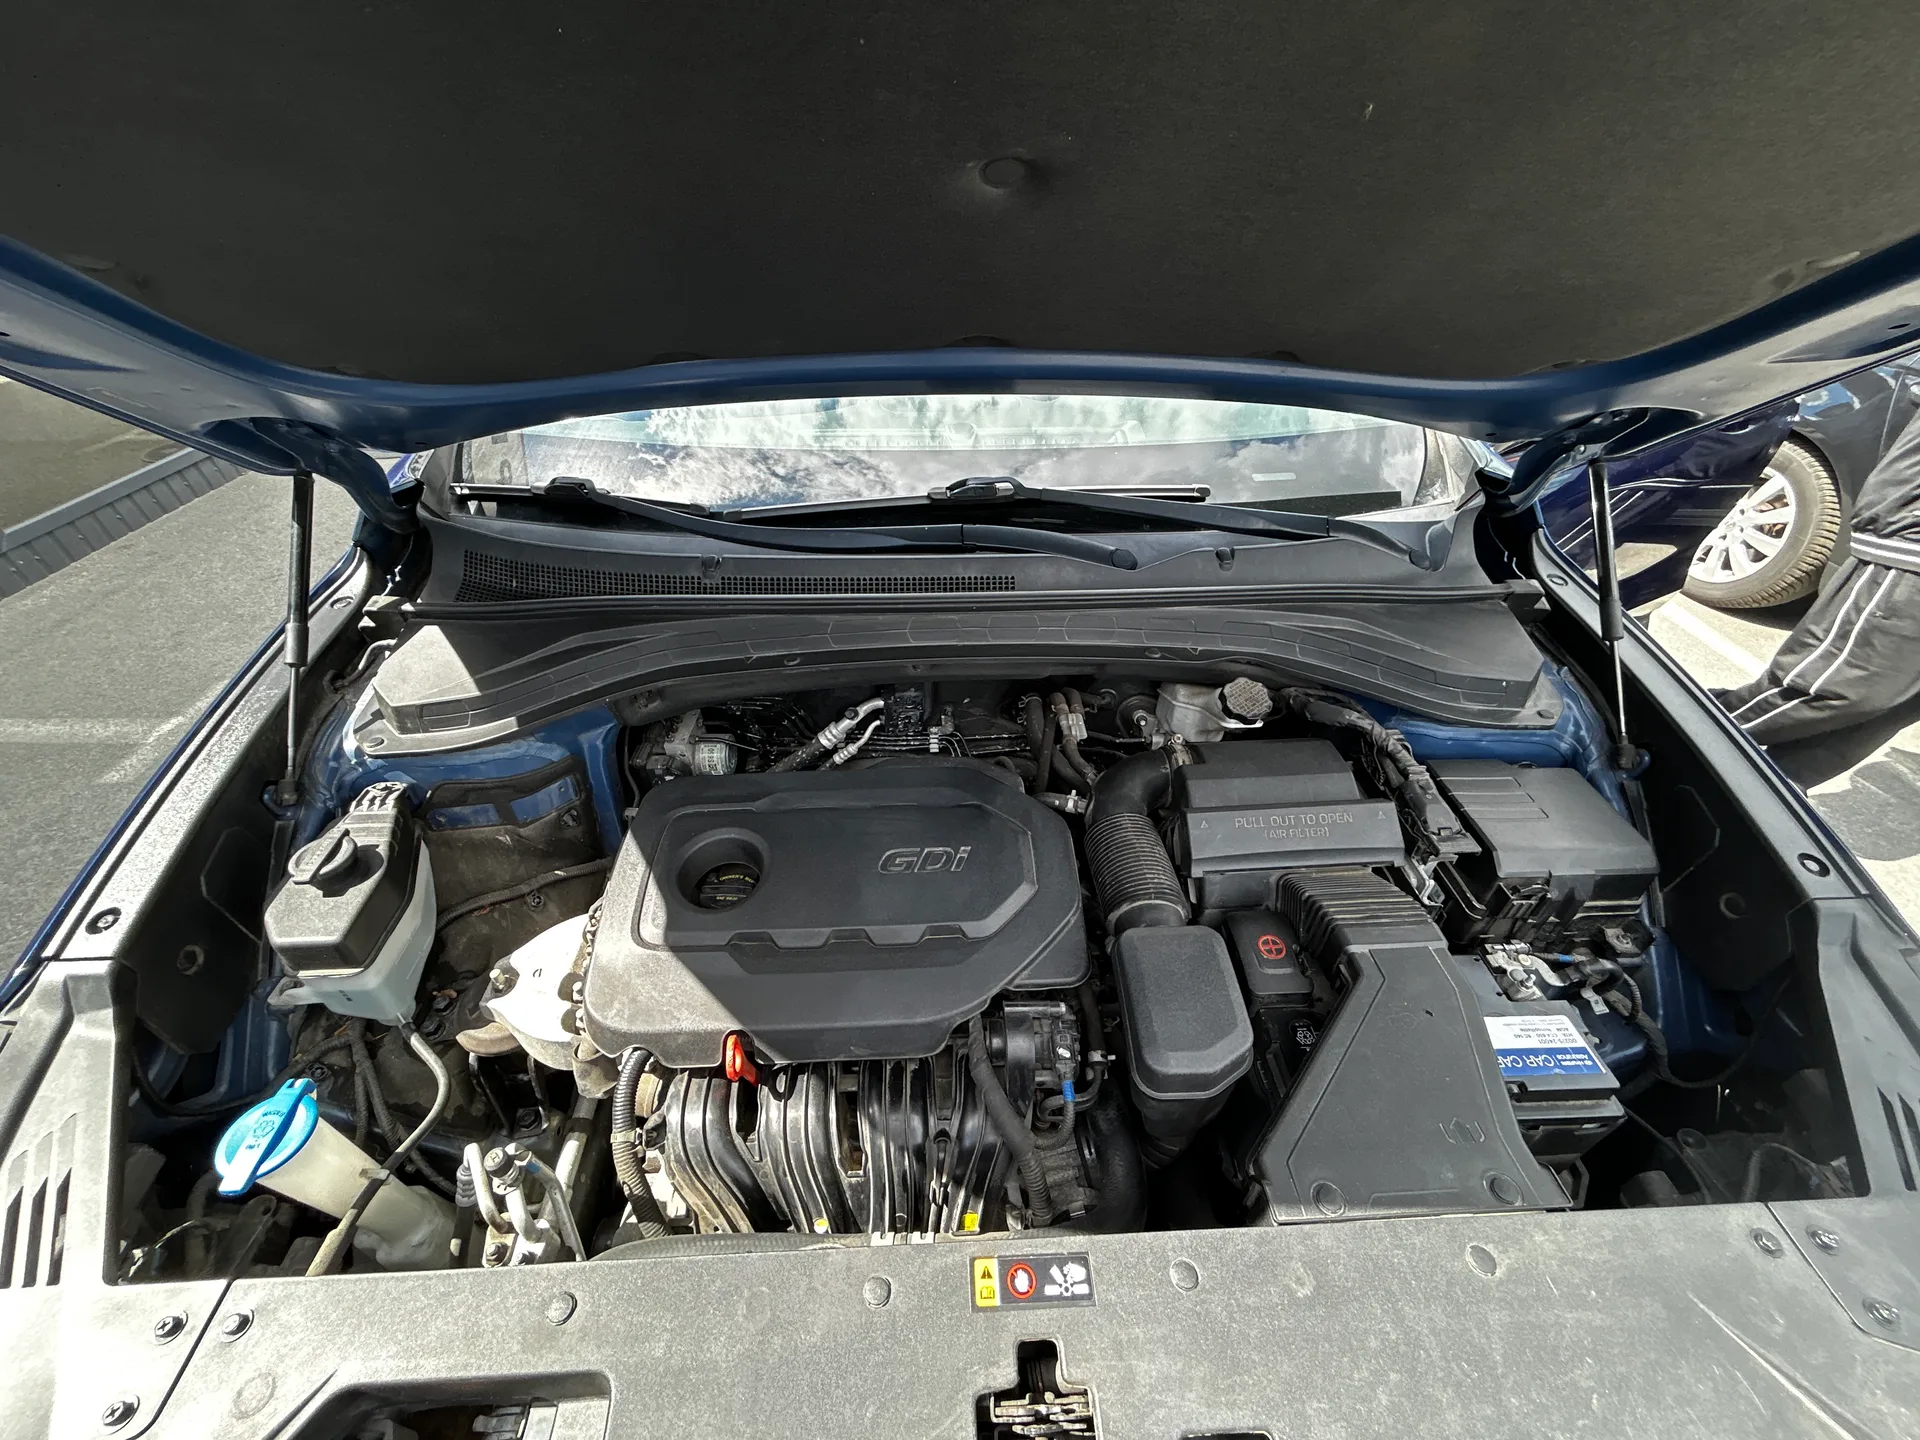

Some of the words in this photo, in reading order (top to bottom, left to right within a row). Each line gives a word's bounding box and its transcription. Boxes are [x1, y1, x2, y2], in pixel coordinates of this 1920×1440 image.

[1235, 816, 1268, 828] PULL
[1270, 815, 1295, 827] OUT
[1299, 814, 1316, 825] TO
[1319, 812, 1353, 825] OPEN
[1522, 1054, 1555, 1067] CAR
